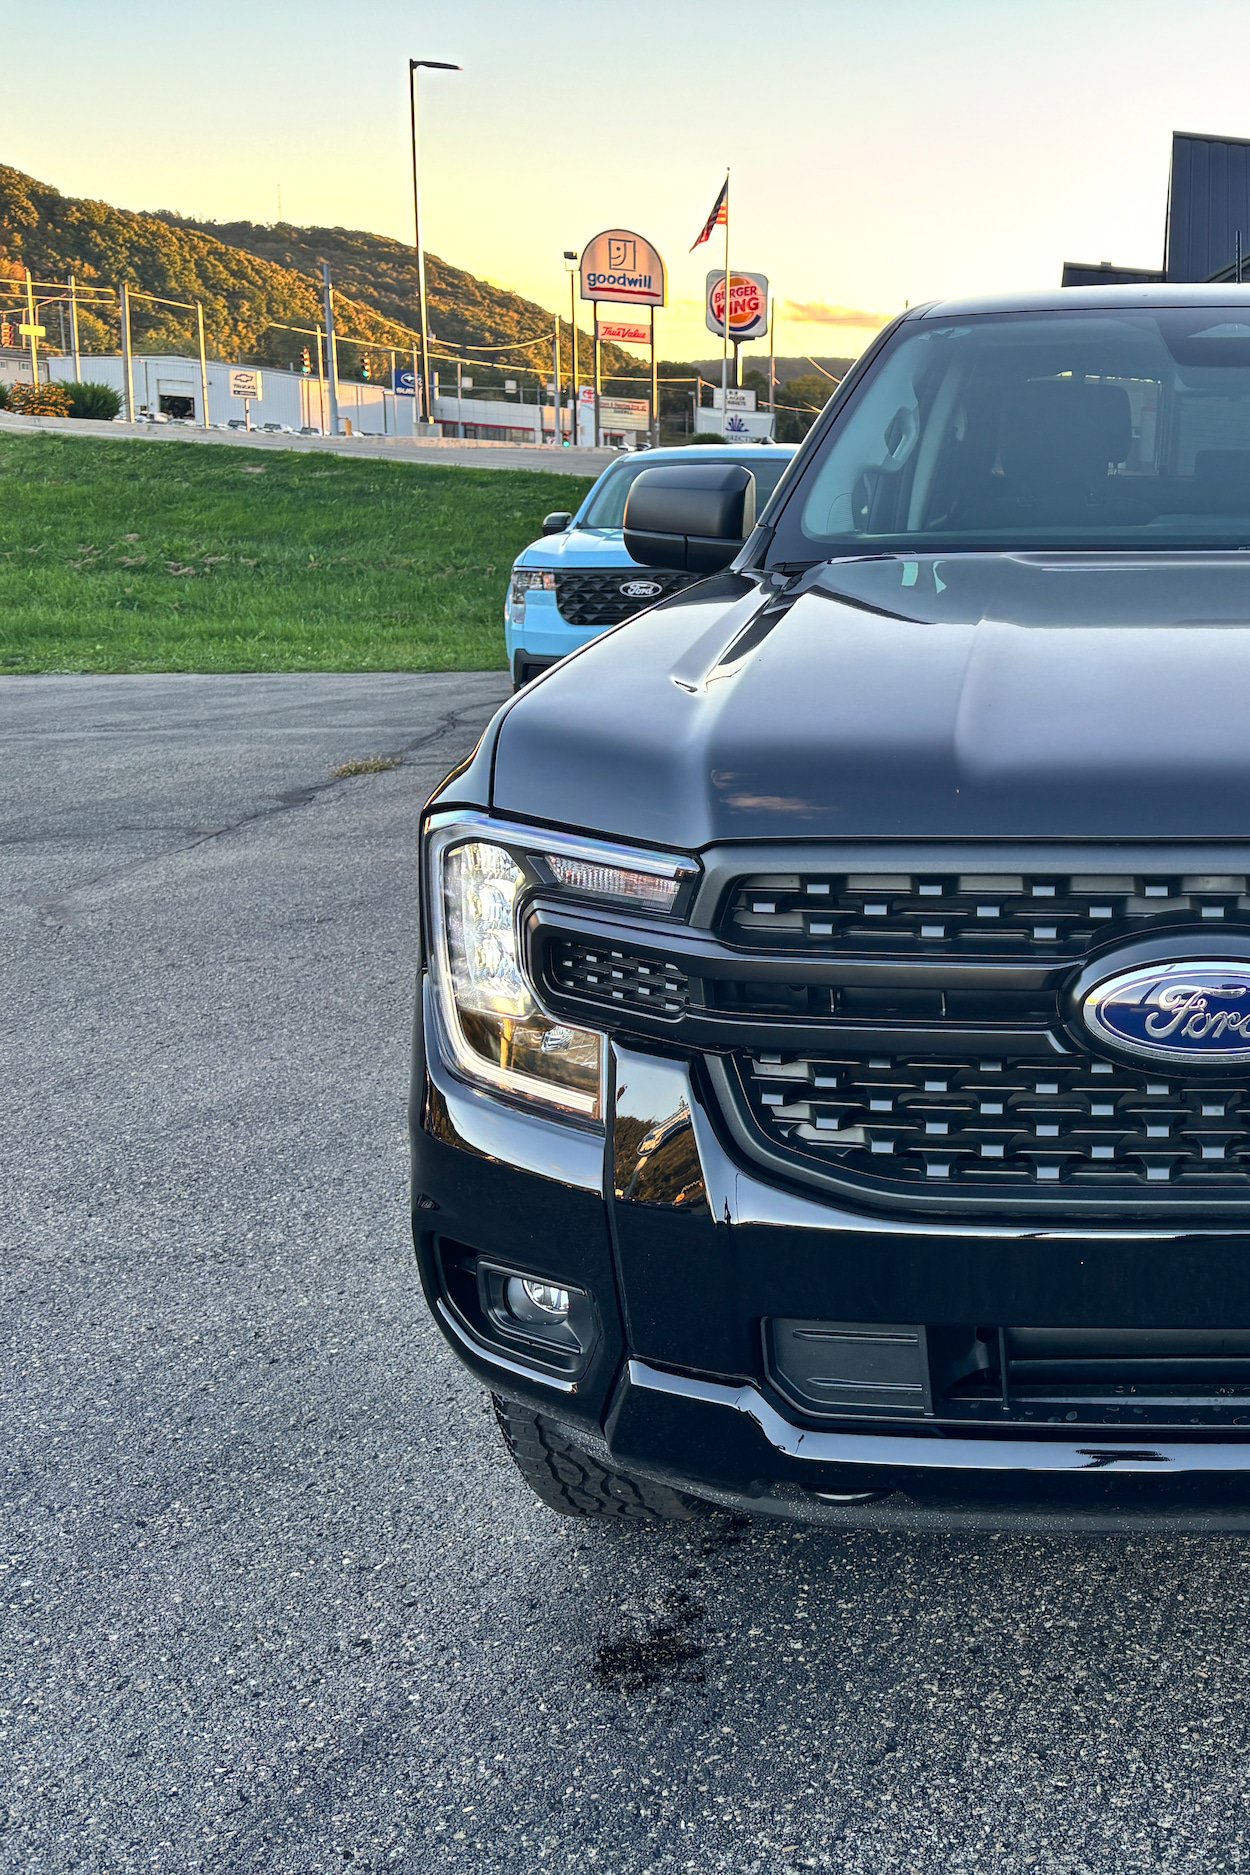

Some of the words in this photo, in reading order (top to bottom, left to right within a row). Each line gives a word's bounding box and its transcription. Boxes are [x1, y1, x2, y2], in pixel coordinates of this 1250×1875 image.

[587, 272, 652, 289] goodwill
[716, 297, 760, 319] KING
[627, 583, 655, 595] Ford
